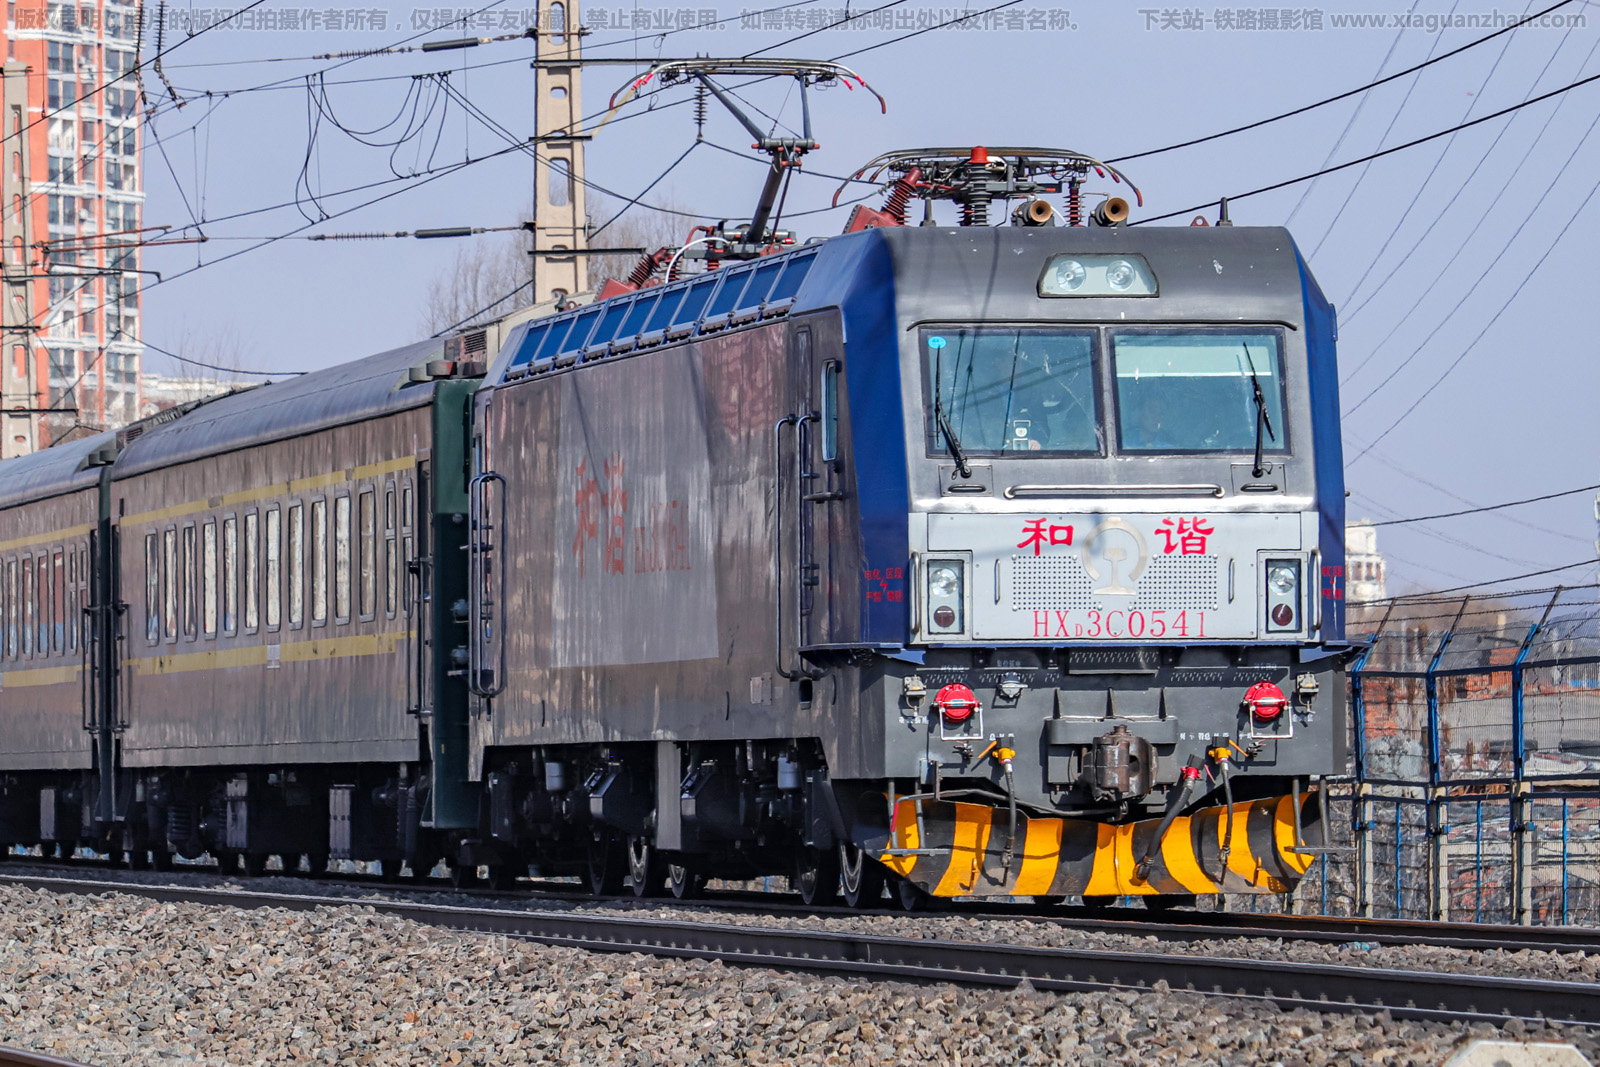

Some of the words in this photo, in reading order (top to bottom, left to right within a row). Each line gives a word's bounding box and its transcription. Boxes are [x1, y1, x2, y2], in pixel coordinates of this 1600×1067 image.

[572, 450, 628, 579] 和谐
[1017, 517, 1074, 556] 和
[1154, 516, 1215, 555] 谐
[1033, 610, 1207, 637] HXD3C0541
